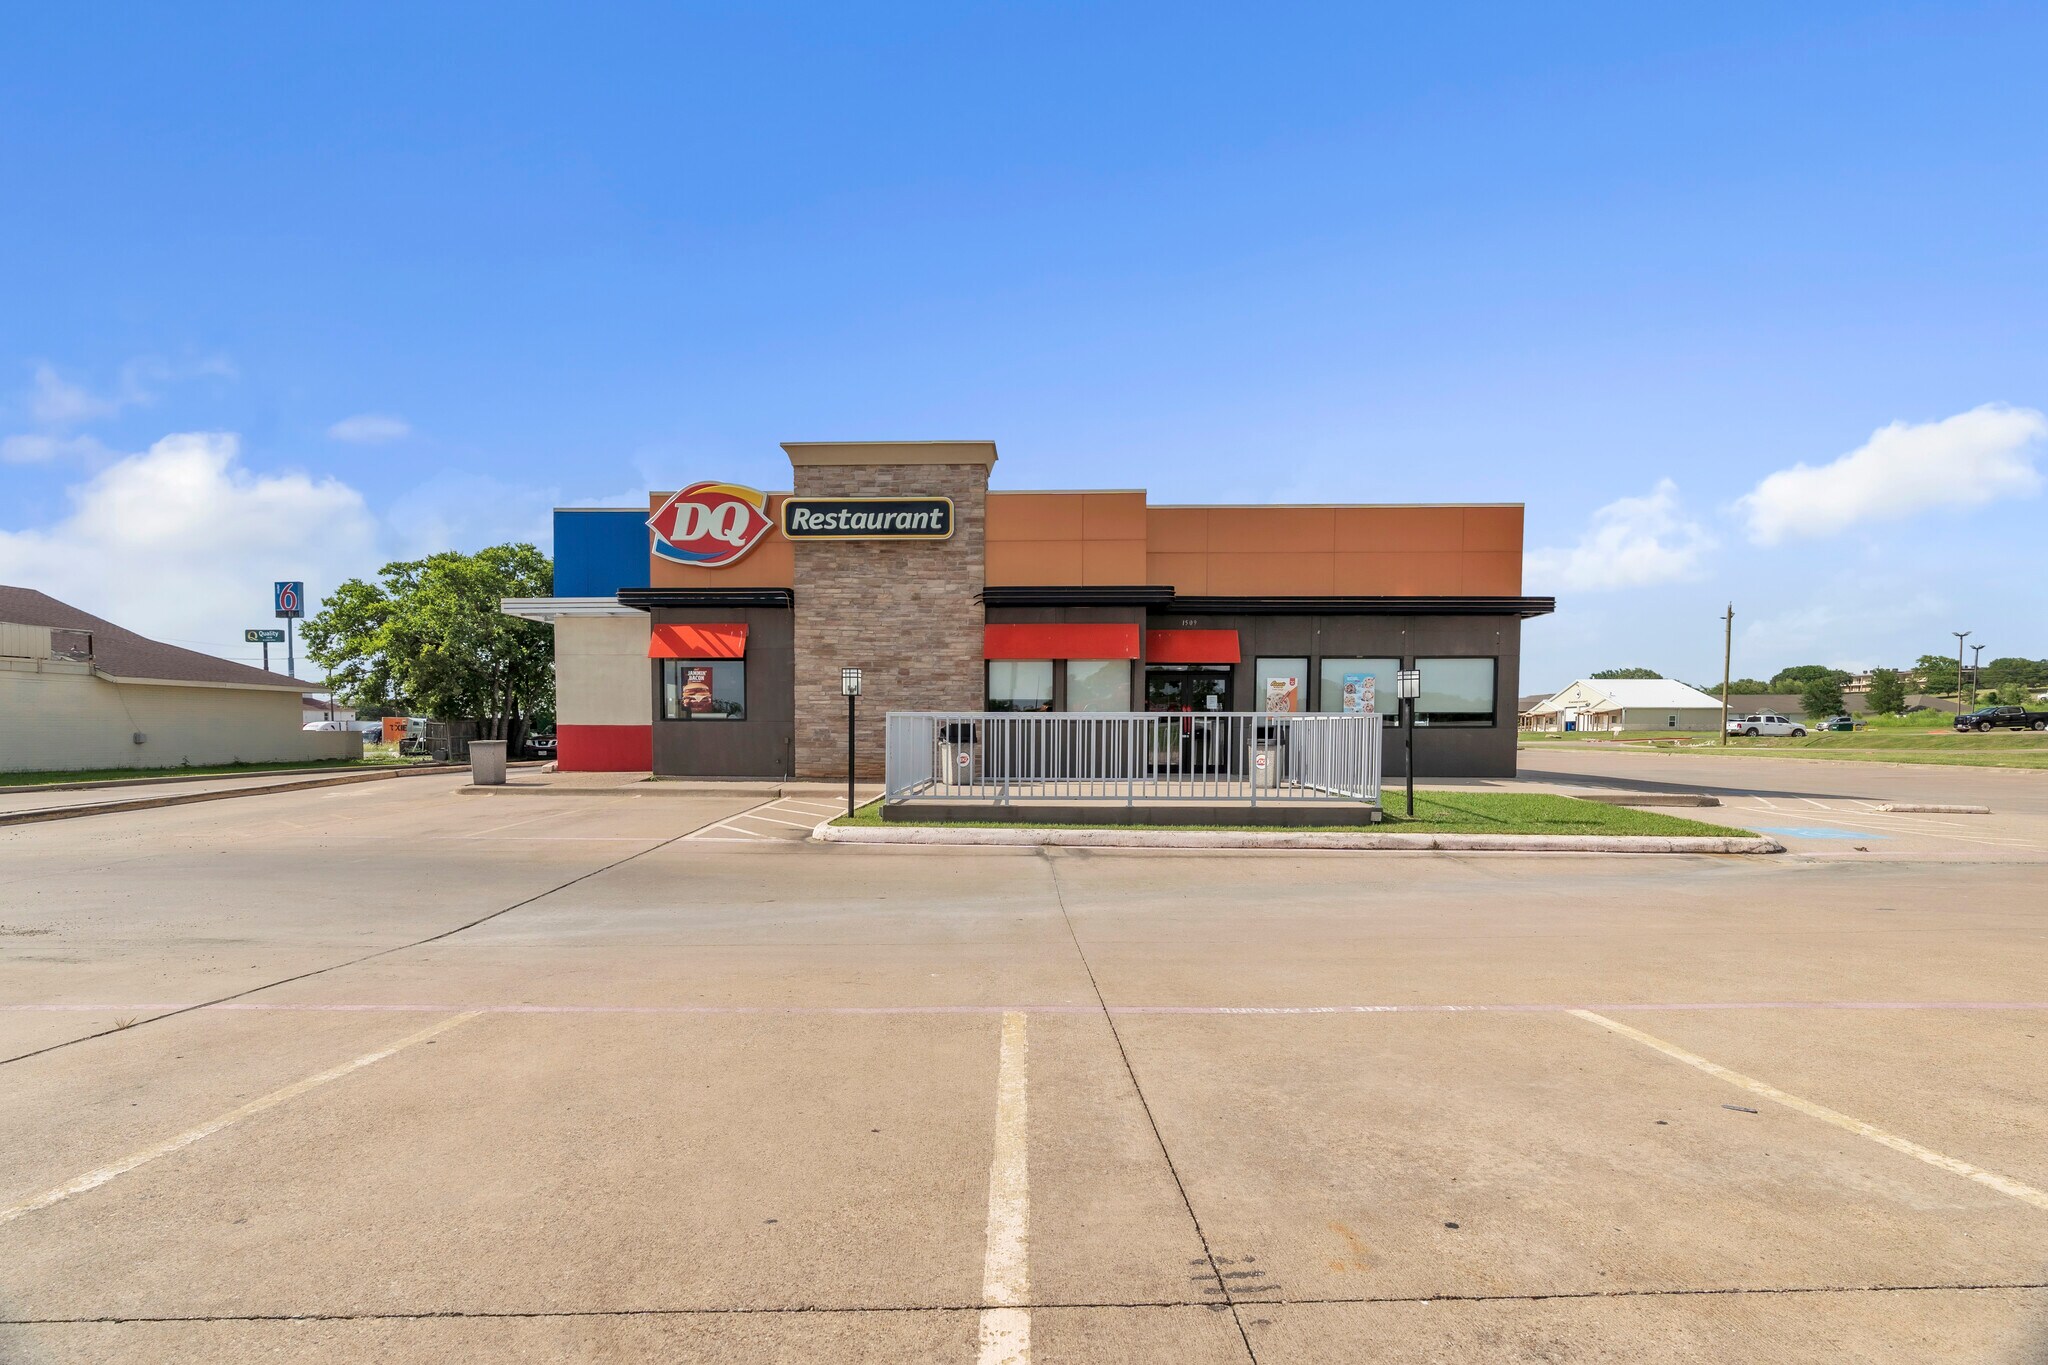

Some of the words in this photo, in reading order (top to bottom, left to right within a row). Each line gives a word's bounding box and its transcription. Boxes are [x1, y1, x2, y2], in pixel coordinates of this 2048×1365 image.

[670, 501, 750, 547] DQ
[792, 508, 944, 530] Restaurant
[279, 583, 298, 611] 6
[258, 630, 279, 638] Quality
